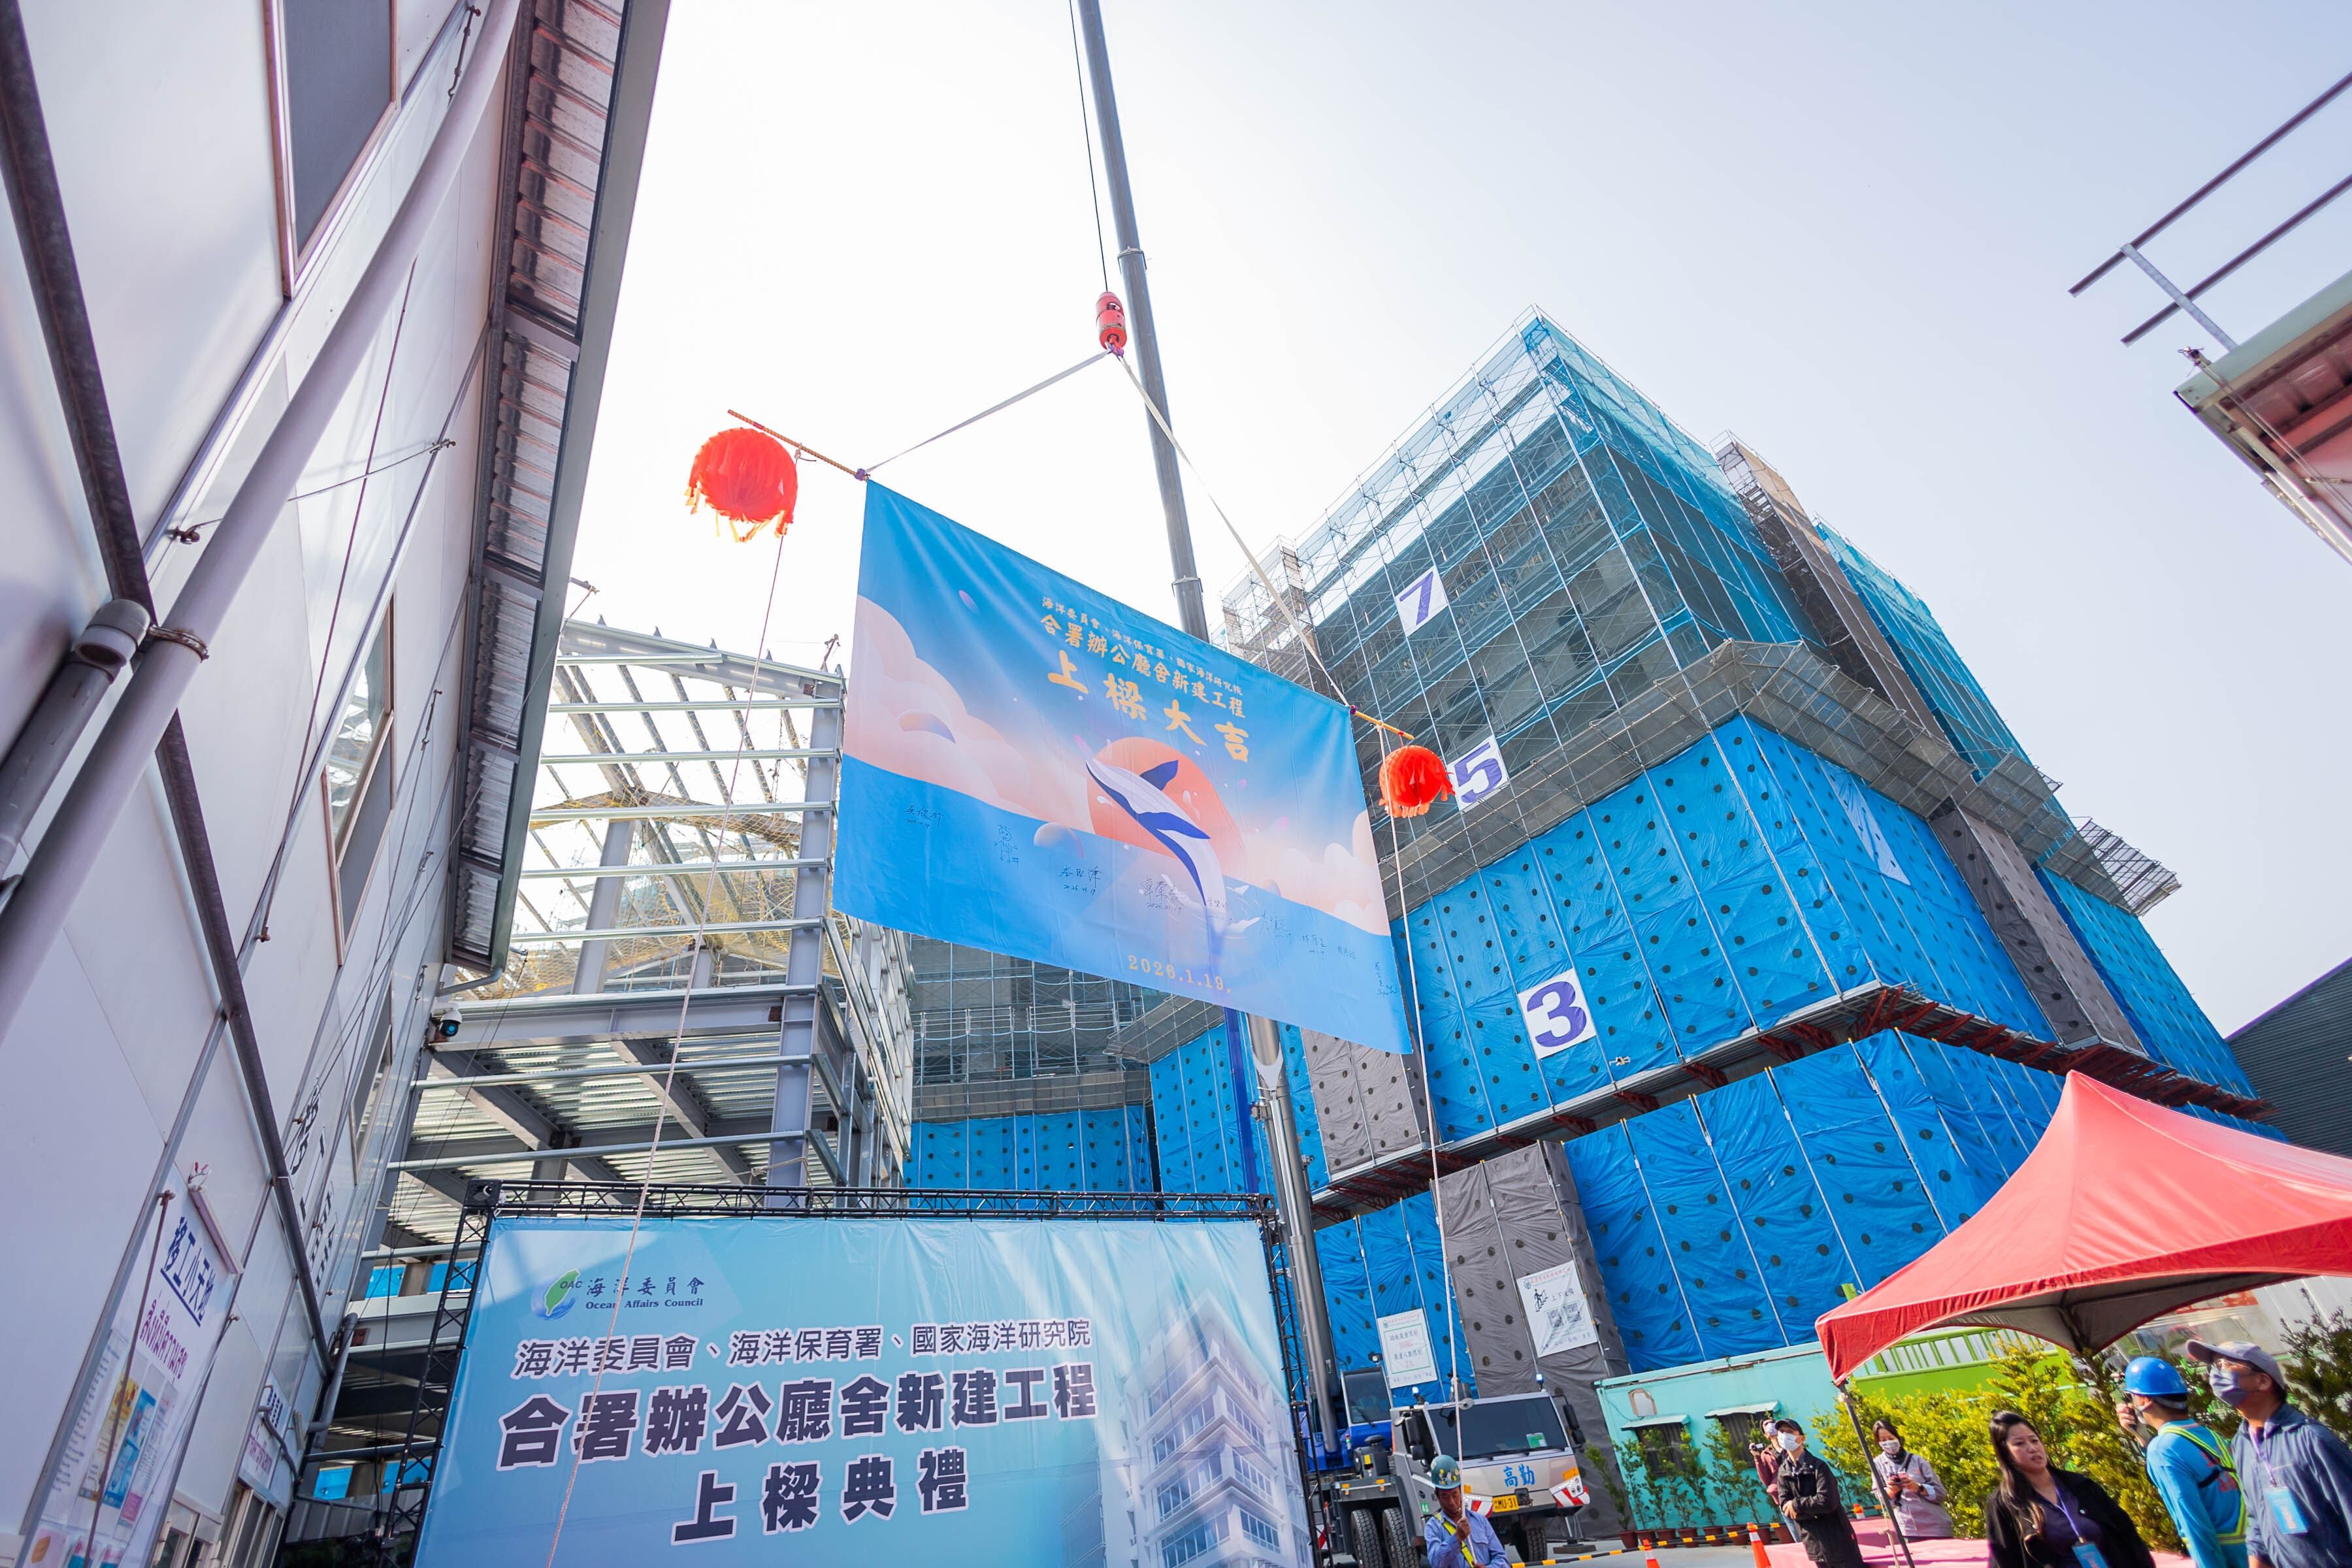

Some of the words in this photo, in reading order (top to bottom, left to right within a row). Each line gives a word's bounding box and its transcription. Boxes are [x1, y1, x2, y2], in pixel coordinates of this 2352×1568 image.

[1399, 570, 1434, 625] 7
[1040, 614, 1245, 719] 合署辦公廳舍新建工程
[1047, 649, 1249, 763] 上樑大吉
[1455, 742, 1503, 804] 5
[1526, 981, 1587, 1047] 3
[560, 1281, 583, 1290] OAC
[586, 1300, 618, 1310] Ocean
[625, 1299, 659, 1309] Affairs
[664, 1298, 703, 1307] Council
[587, 1276, 705, 1297] 海洋委員會
[516, 1320, 1092, 1376] 海洋委員會、海洋保育署、國家海洋研究院
[498, 1364, 1096, 1466] 合署辦公廳舍新建工程
[674, 1448, 966, 1543] 上樑典禮
[1503, 1463, 1535, 1488] 高勤
